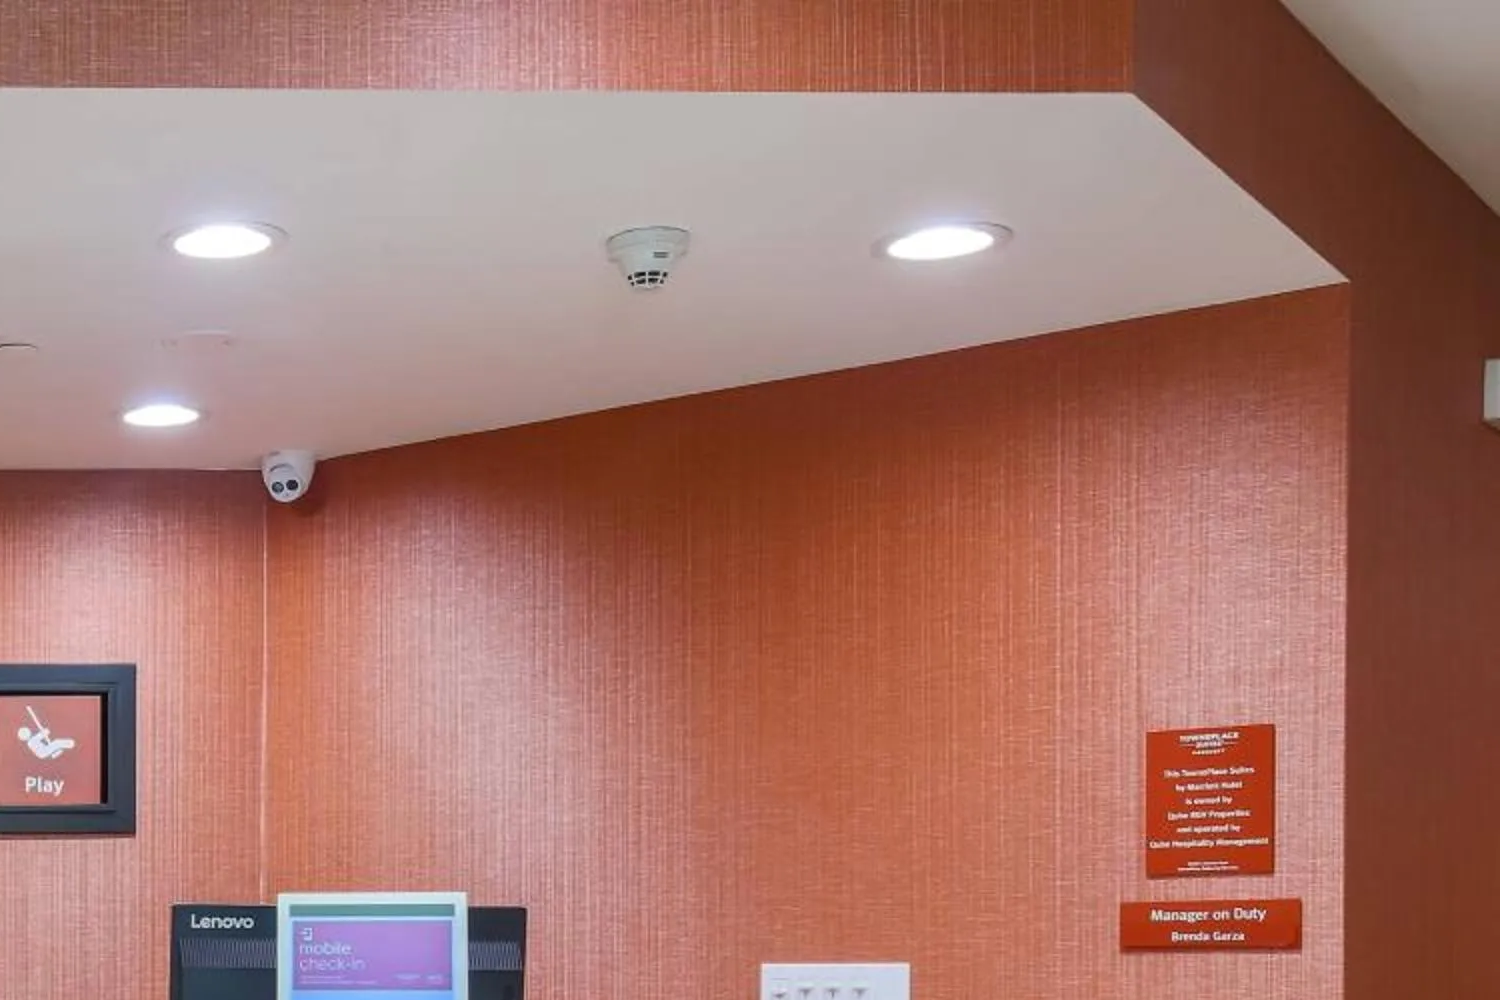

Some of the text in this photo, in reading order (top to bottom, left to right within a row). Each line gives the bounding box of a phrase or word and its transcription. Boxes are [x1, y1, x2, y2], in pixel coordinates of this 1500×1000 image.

[25, 776, 64, 796] Play
[191, 913, 255, 930] Lenovo
[1150, 906, 1267, 923] Manager on Duty
[1171, 930, 1245, 942] Brenda Garza
[299, 941, 352, 956] mobile
[299, 957, 367, 972] check-in
